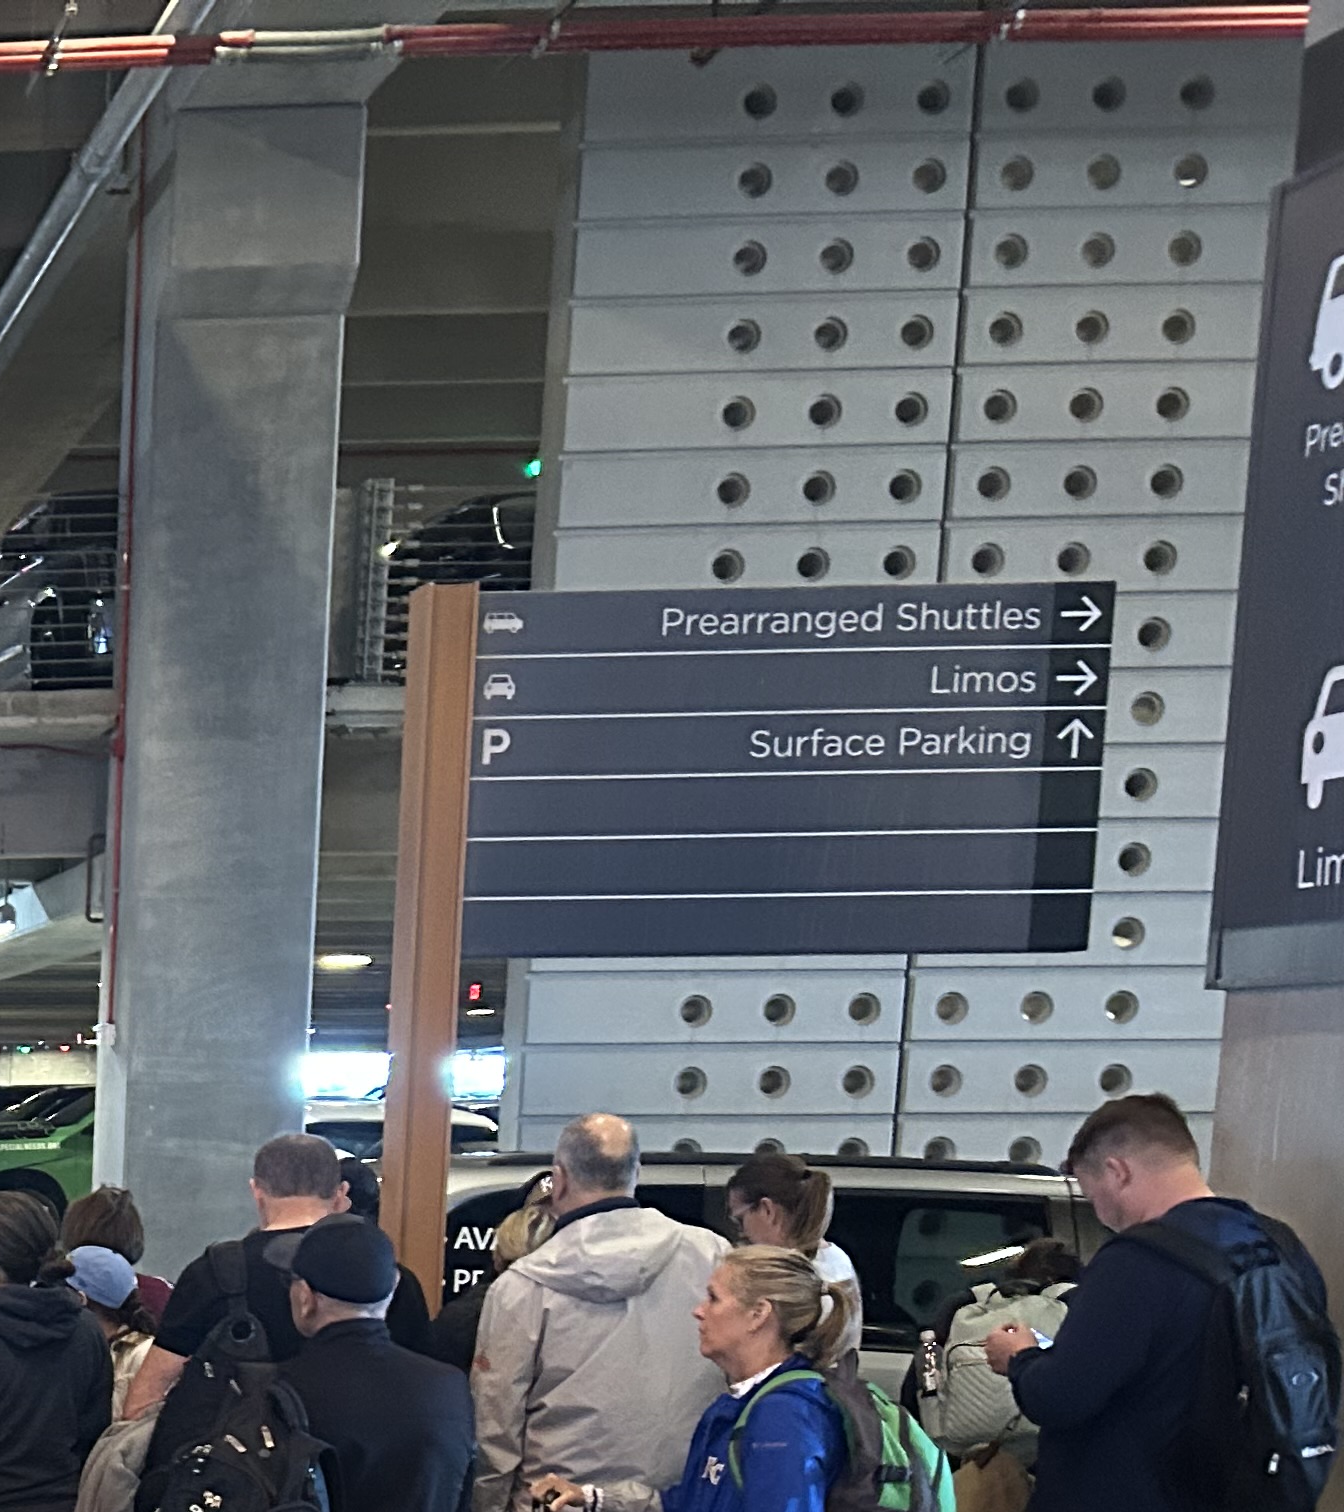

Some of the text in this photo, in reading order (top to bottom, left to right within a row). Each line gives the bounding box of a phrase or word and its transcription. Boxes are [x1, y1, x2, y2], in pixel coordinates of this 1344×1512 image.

[662, 600, 1041, 639] Prearranged Shuttles
[931, 664, 1036, 695] Limos
[482, 728, 511, 765] P
[749, 726, 1032, 760] Surface Parking
[701, 1455, 725, 1486] KC
